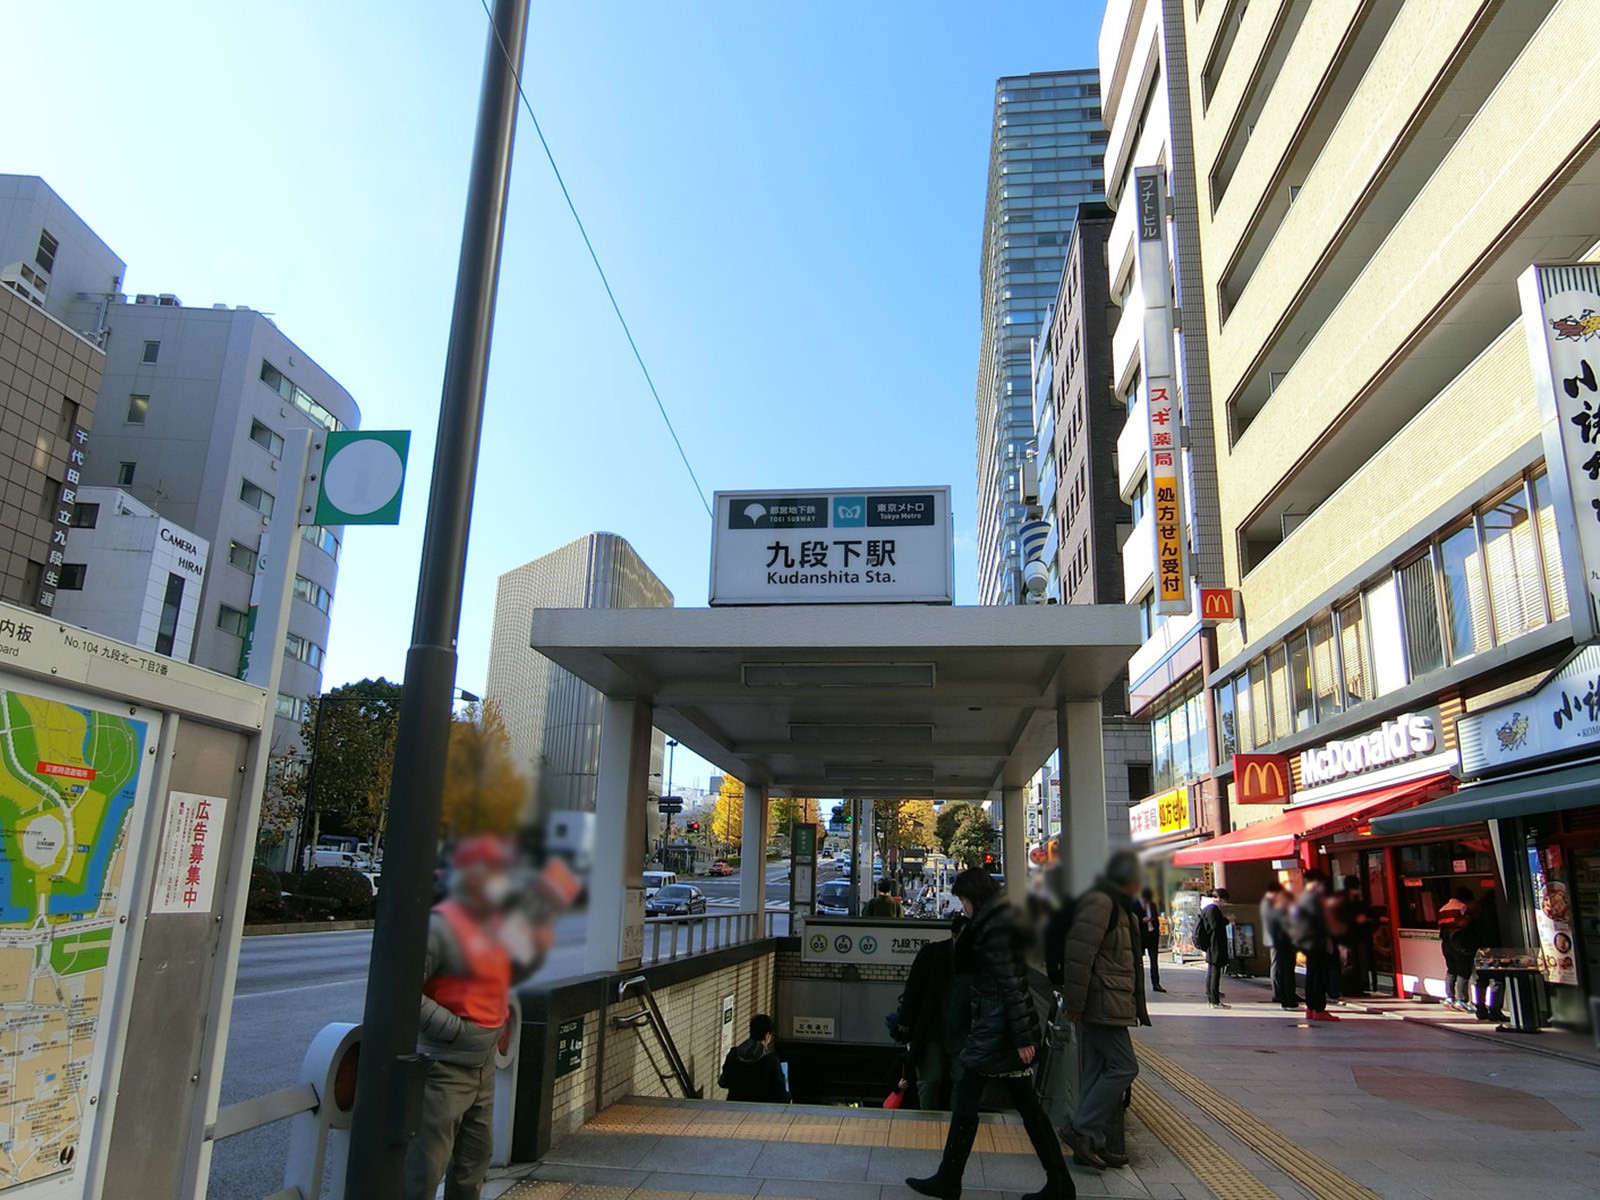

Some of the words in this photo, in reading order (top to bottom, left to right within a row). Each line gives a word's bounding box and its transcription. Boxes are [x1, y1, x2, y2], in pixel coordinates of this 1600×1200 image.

[1140, 179, 1157, 238] フナトビル
[1150, 387, 1173, 467] スギ薬局
[769, 505, 816, 515] 都営地下鉄
[787, 515, 816, 523] SUBWAY
[876, 502, 925, 513] 東京メトロ
[879, 512, 900, 521] Tokyo
[900, 512, 922, 520] Metro
[39, 429, 88, 617] 千代田区立九段生涯
[160, 528, 197, 556] CAMERA
[1157, 486, 1181, 593] 処方せん受付
[178, 556, 203, 576] HIRAI
[766, 540, 896, 569] 九段下駅
[767, 570, 860, 584] Kudanshita
[865, 569, 896, 584] Sta.
[0, 619, 34, 643] 内板
[64, 635, 99, 654] No.104
[101, 646, 169, 676] 九段北一丁目2番
[1300, 712, 1435, 785] McDonald's
[1131, 808, 1158, 833] スギ薬局
[1159, 797, 1187, 827] 処方せん
[183, 799, 212, 909] 広告募集中
[813, 942, 824, 950] 05
[838, 942, 849, 950] 06
[863, 943, 873, 951] 07
